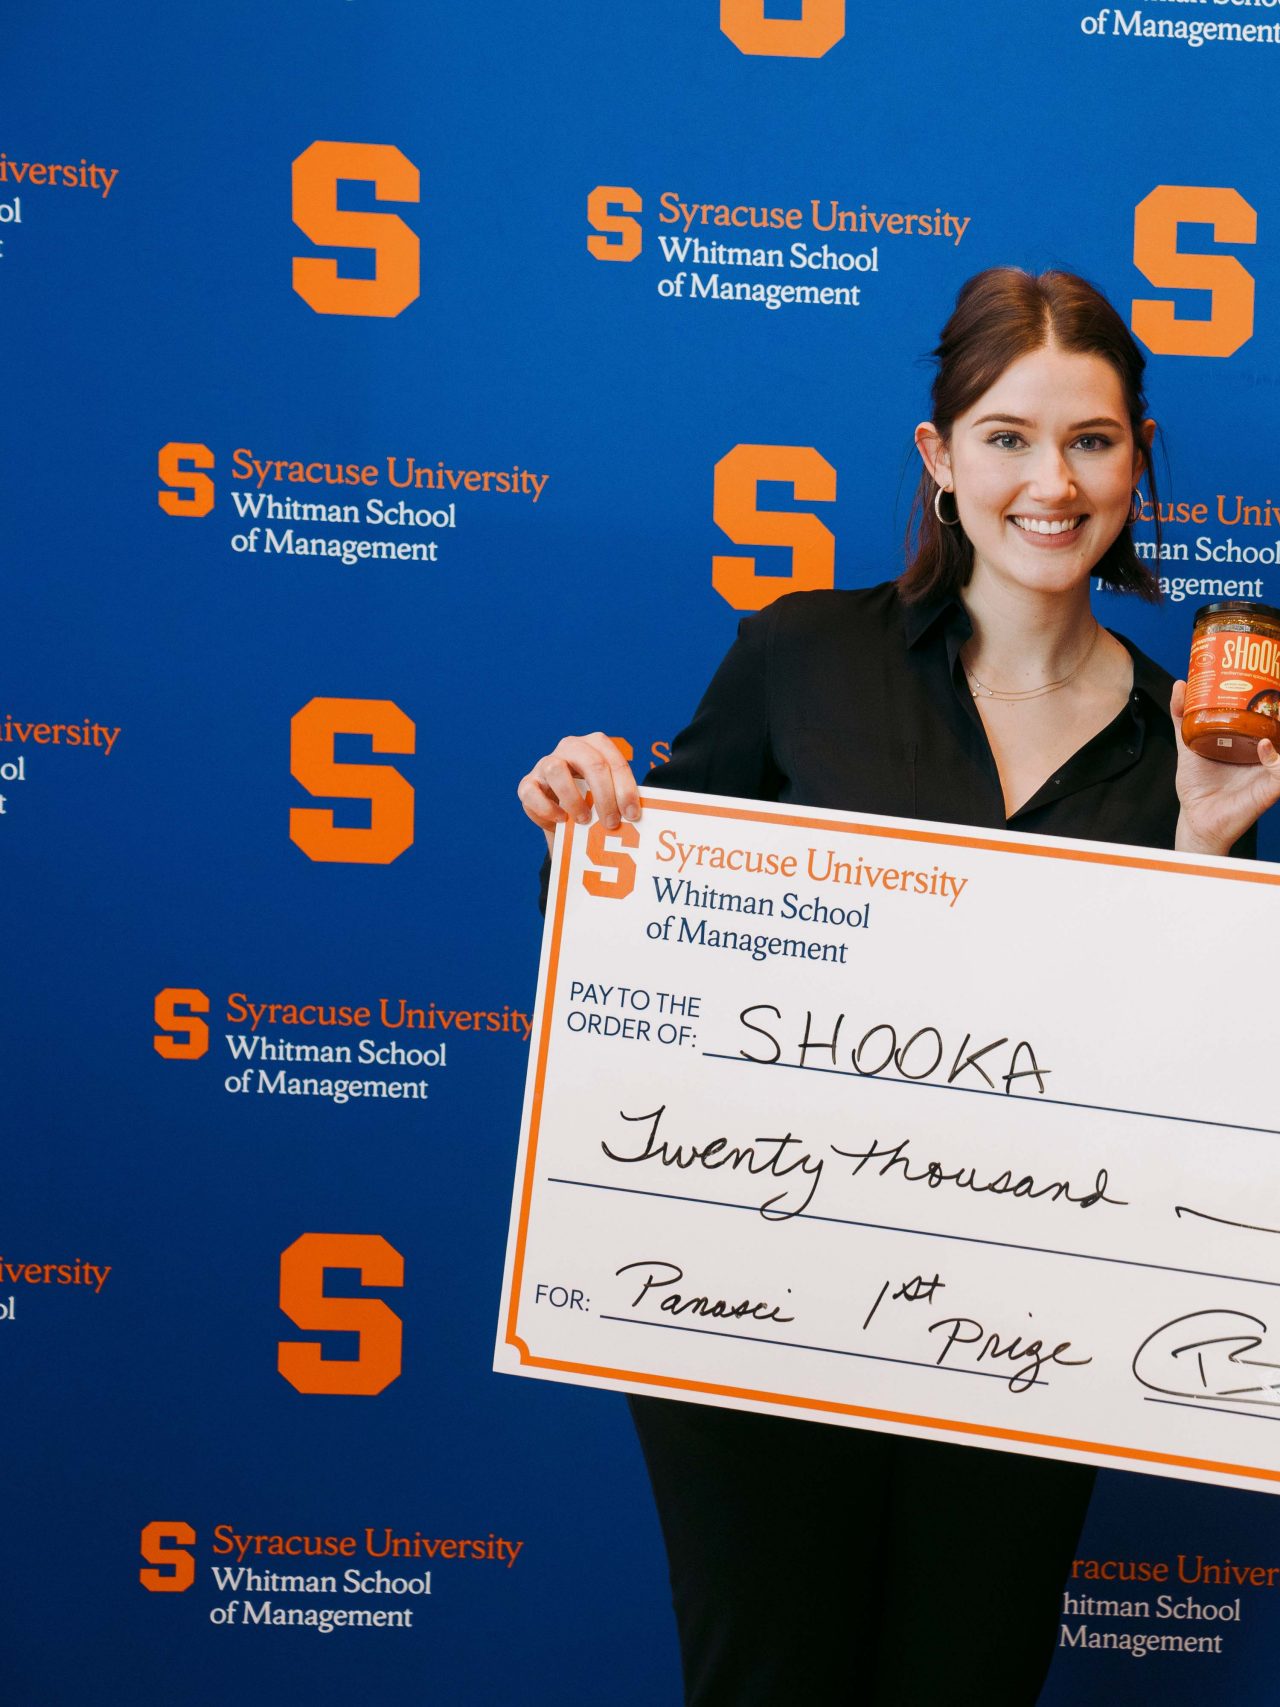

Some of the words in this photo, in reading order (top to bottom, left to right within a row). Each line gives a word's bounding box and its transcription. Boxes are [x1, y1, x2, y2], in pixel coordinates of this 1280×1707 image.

[1081, 9, 1110, 35] of
[0, 153, 118, 198] iversity
[292, 141, 420, 318] S
[587, 186, 642, 262] S
[659, 192, 803, 231] Syracuse
[812, 199, 970, 244] University
[658, 231, 784, 267] Whitman
[790, 231, 878, 271] School
[1132, 185, 1257, 358] S
[658, 272, 687, 297] of
[689, 272, 860, 310] Management
[157, 441, 214, 518] S
[232, 448, 379, 488] Syracuse
[388, 457, 549, 502] University
[231, 488, 360, 523] Whitman
[366, 488, 456, 527] School
[712, 444, 837, 611] S
[1134, 502, 1208, 524] cuse
[231, 527, 261, 552] of
[264, 528, 437, 565] Management
[0, 714, 121, 756] iversity
[289, 697, 416, 865] S
[655, 829, 798, 878] Syracuse
[806, 848, 969, 908] University
[652, 876, 775, 918] Whitman
[780, 893, 871, 929] School
[646, 916, 676, 942] of
[677, 918, 849, 964] Management
[226, 992, 371, 1031] Syracuse
[379, 997, 535, 1041] University
[569, 981, 614, 1007] PAY
[617, 985, 651, 1012] TO
[656, 991, 701, 1018] THE
[153, 987, 211, 1061] S
[567, 1010, 652, 1042] ORDER
[657, 1021, 698, 1049] OF:
[226, 1034, 352, 1063] Whitman
[358, 1040, 447, 1067] School
[739, 1004, 1052, 1094] SHOOKA
[225, 1069, 254, 1093] of
[257, 1069, 428, 1103] Management
[600, 1105, 825, 1221] Twenty
[277, 1231, 404, 1397] S
[535, 1282, 591, 1313] FOR:
[928, 1312, 1093, 1394] Prize
[138, 1520, 197, 1594] S
[212, 1523, 358, 1563] Syracuse
[365, 1528, 524, 1568] University
[211, 1566, 337, 1593] Whitman
[344, 1569, 432, 1595] School
[1071, 1559, 1169, 1583] racuse
[210, 1601, 239, 1624] of
[242, 1601, 413, 1633] Management
[1062, 1592, 1150, 1618] hitman
[1156, 1594, 1241, 1621] School
[1059, 1624, 1223, 1658] Management
